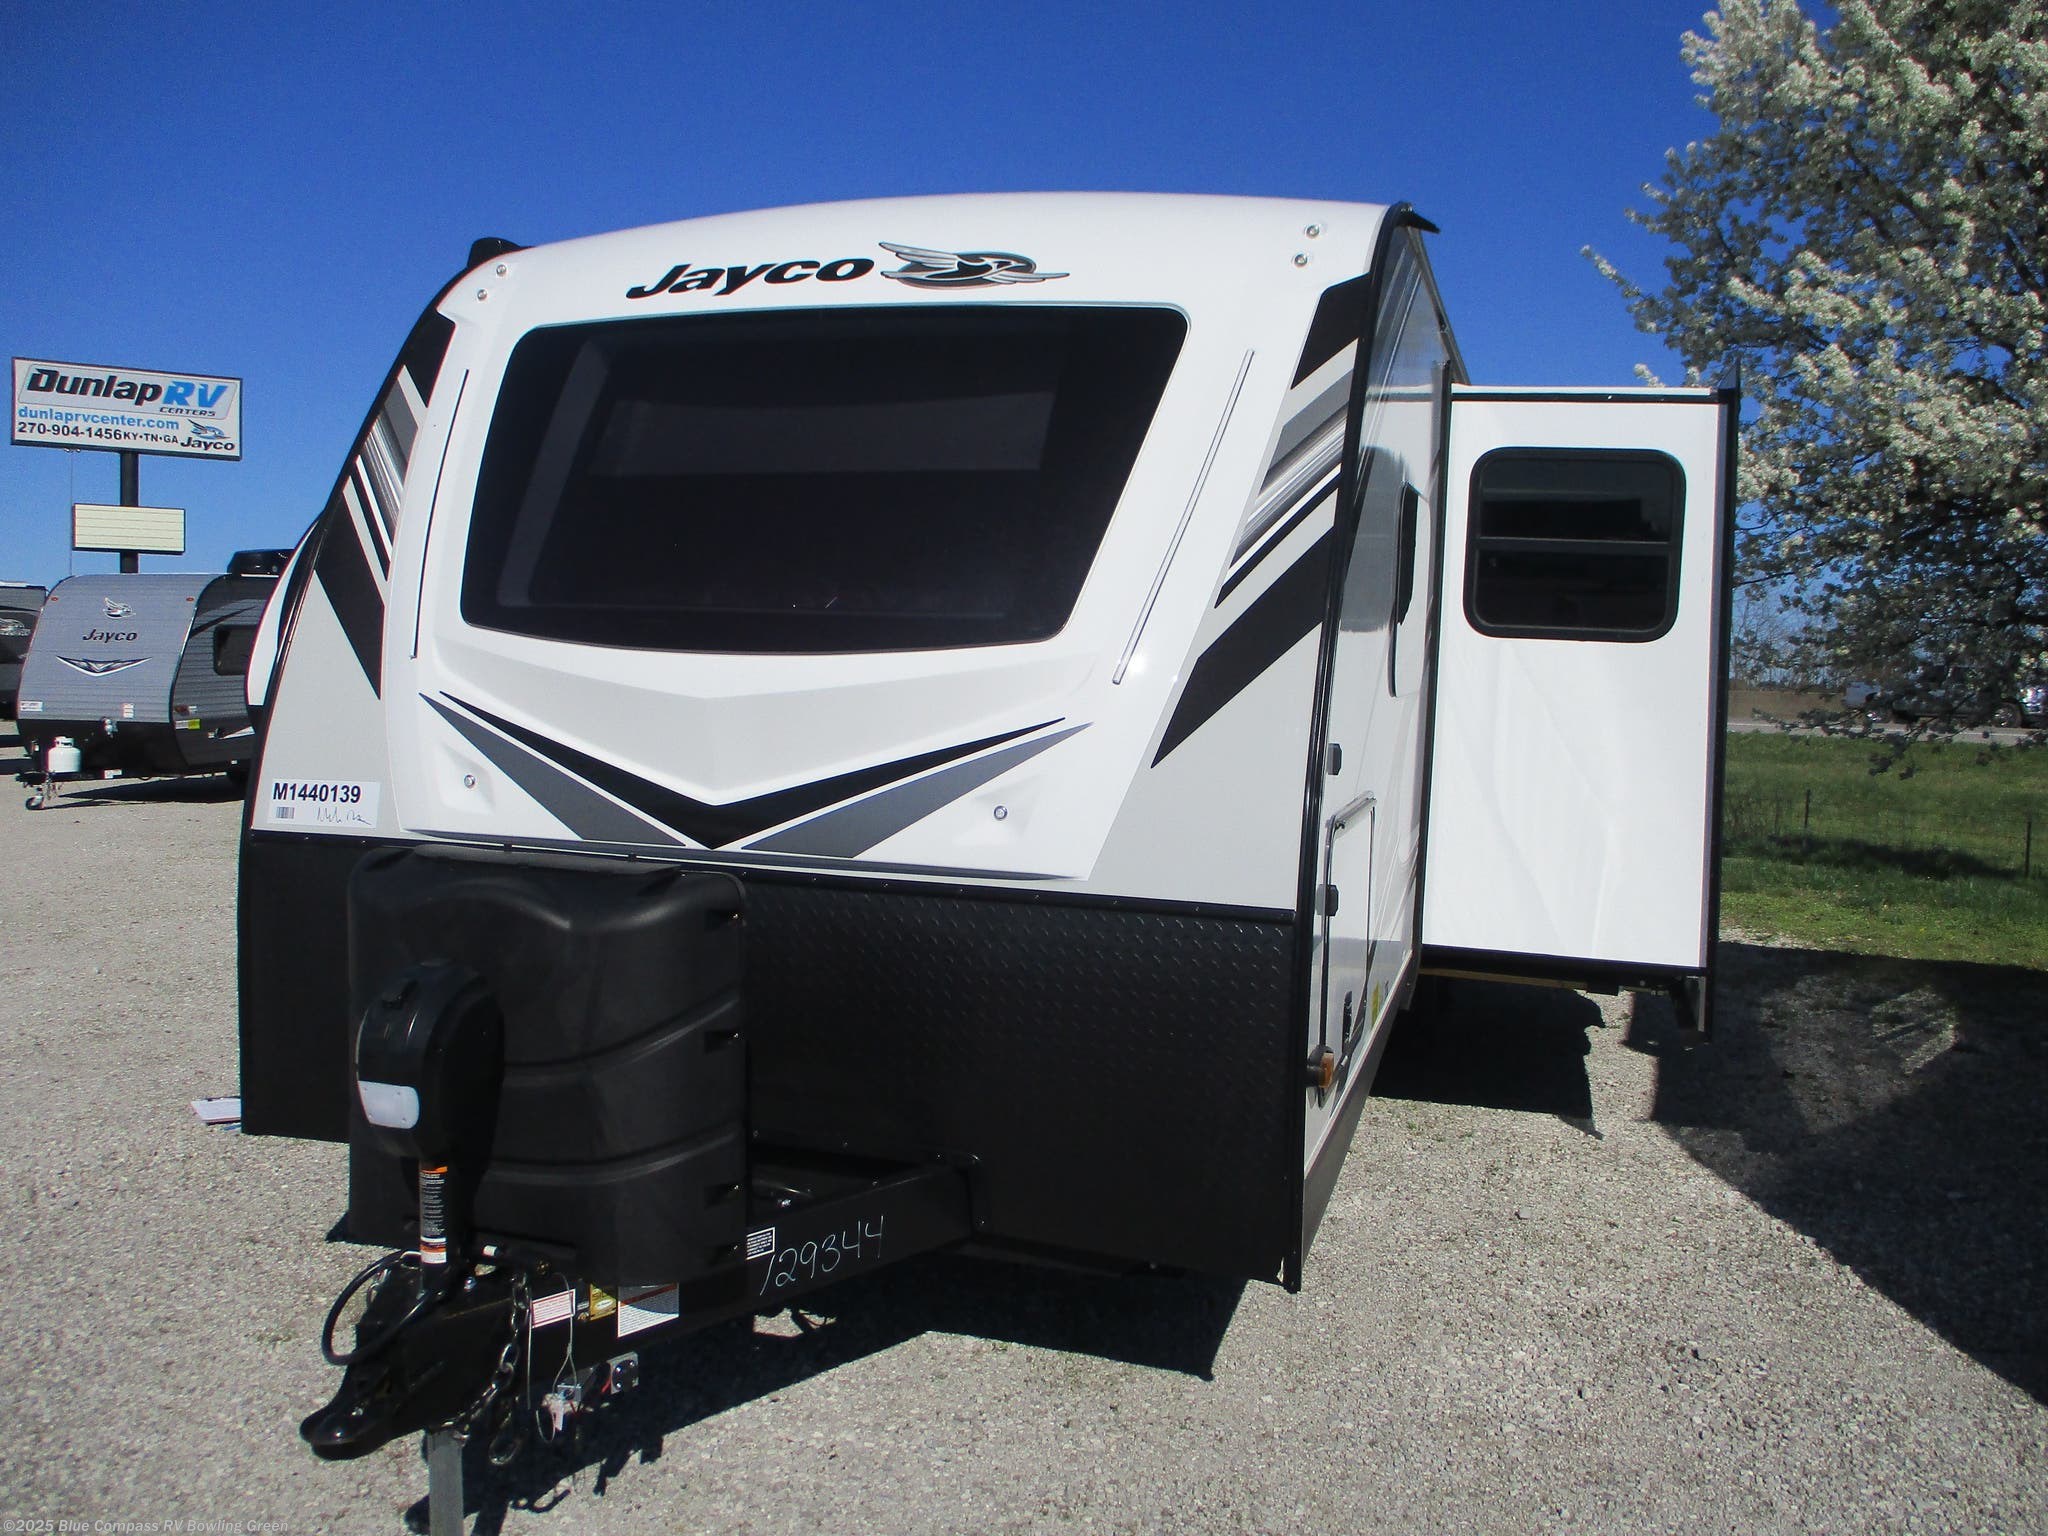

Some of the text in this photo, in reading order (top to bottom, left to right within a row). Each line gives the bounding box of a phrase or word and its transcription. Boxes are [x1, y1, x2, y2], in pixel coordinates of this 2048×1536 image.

[625, 258, 875, 299] Jayco
[26, 368, 228, 408] Dunlap RV
[18, 406, 179, 430] dunlaprvcenter.com
[159, 406, 216, 417] CENTERS
[18, 421, 122, 440] 270-904-1456
[180, 436, 235, 451] Jayco
[82, 628, 138, 643] Jayco
[273, 782, 361, 803] M1440139
